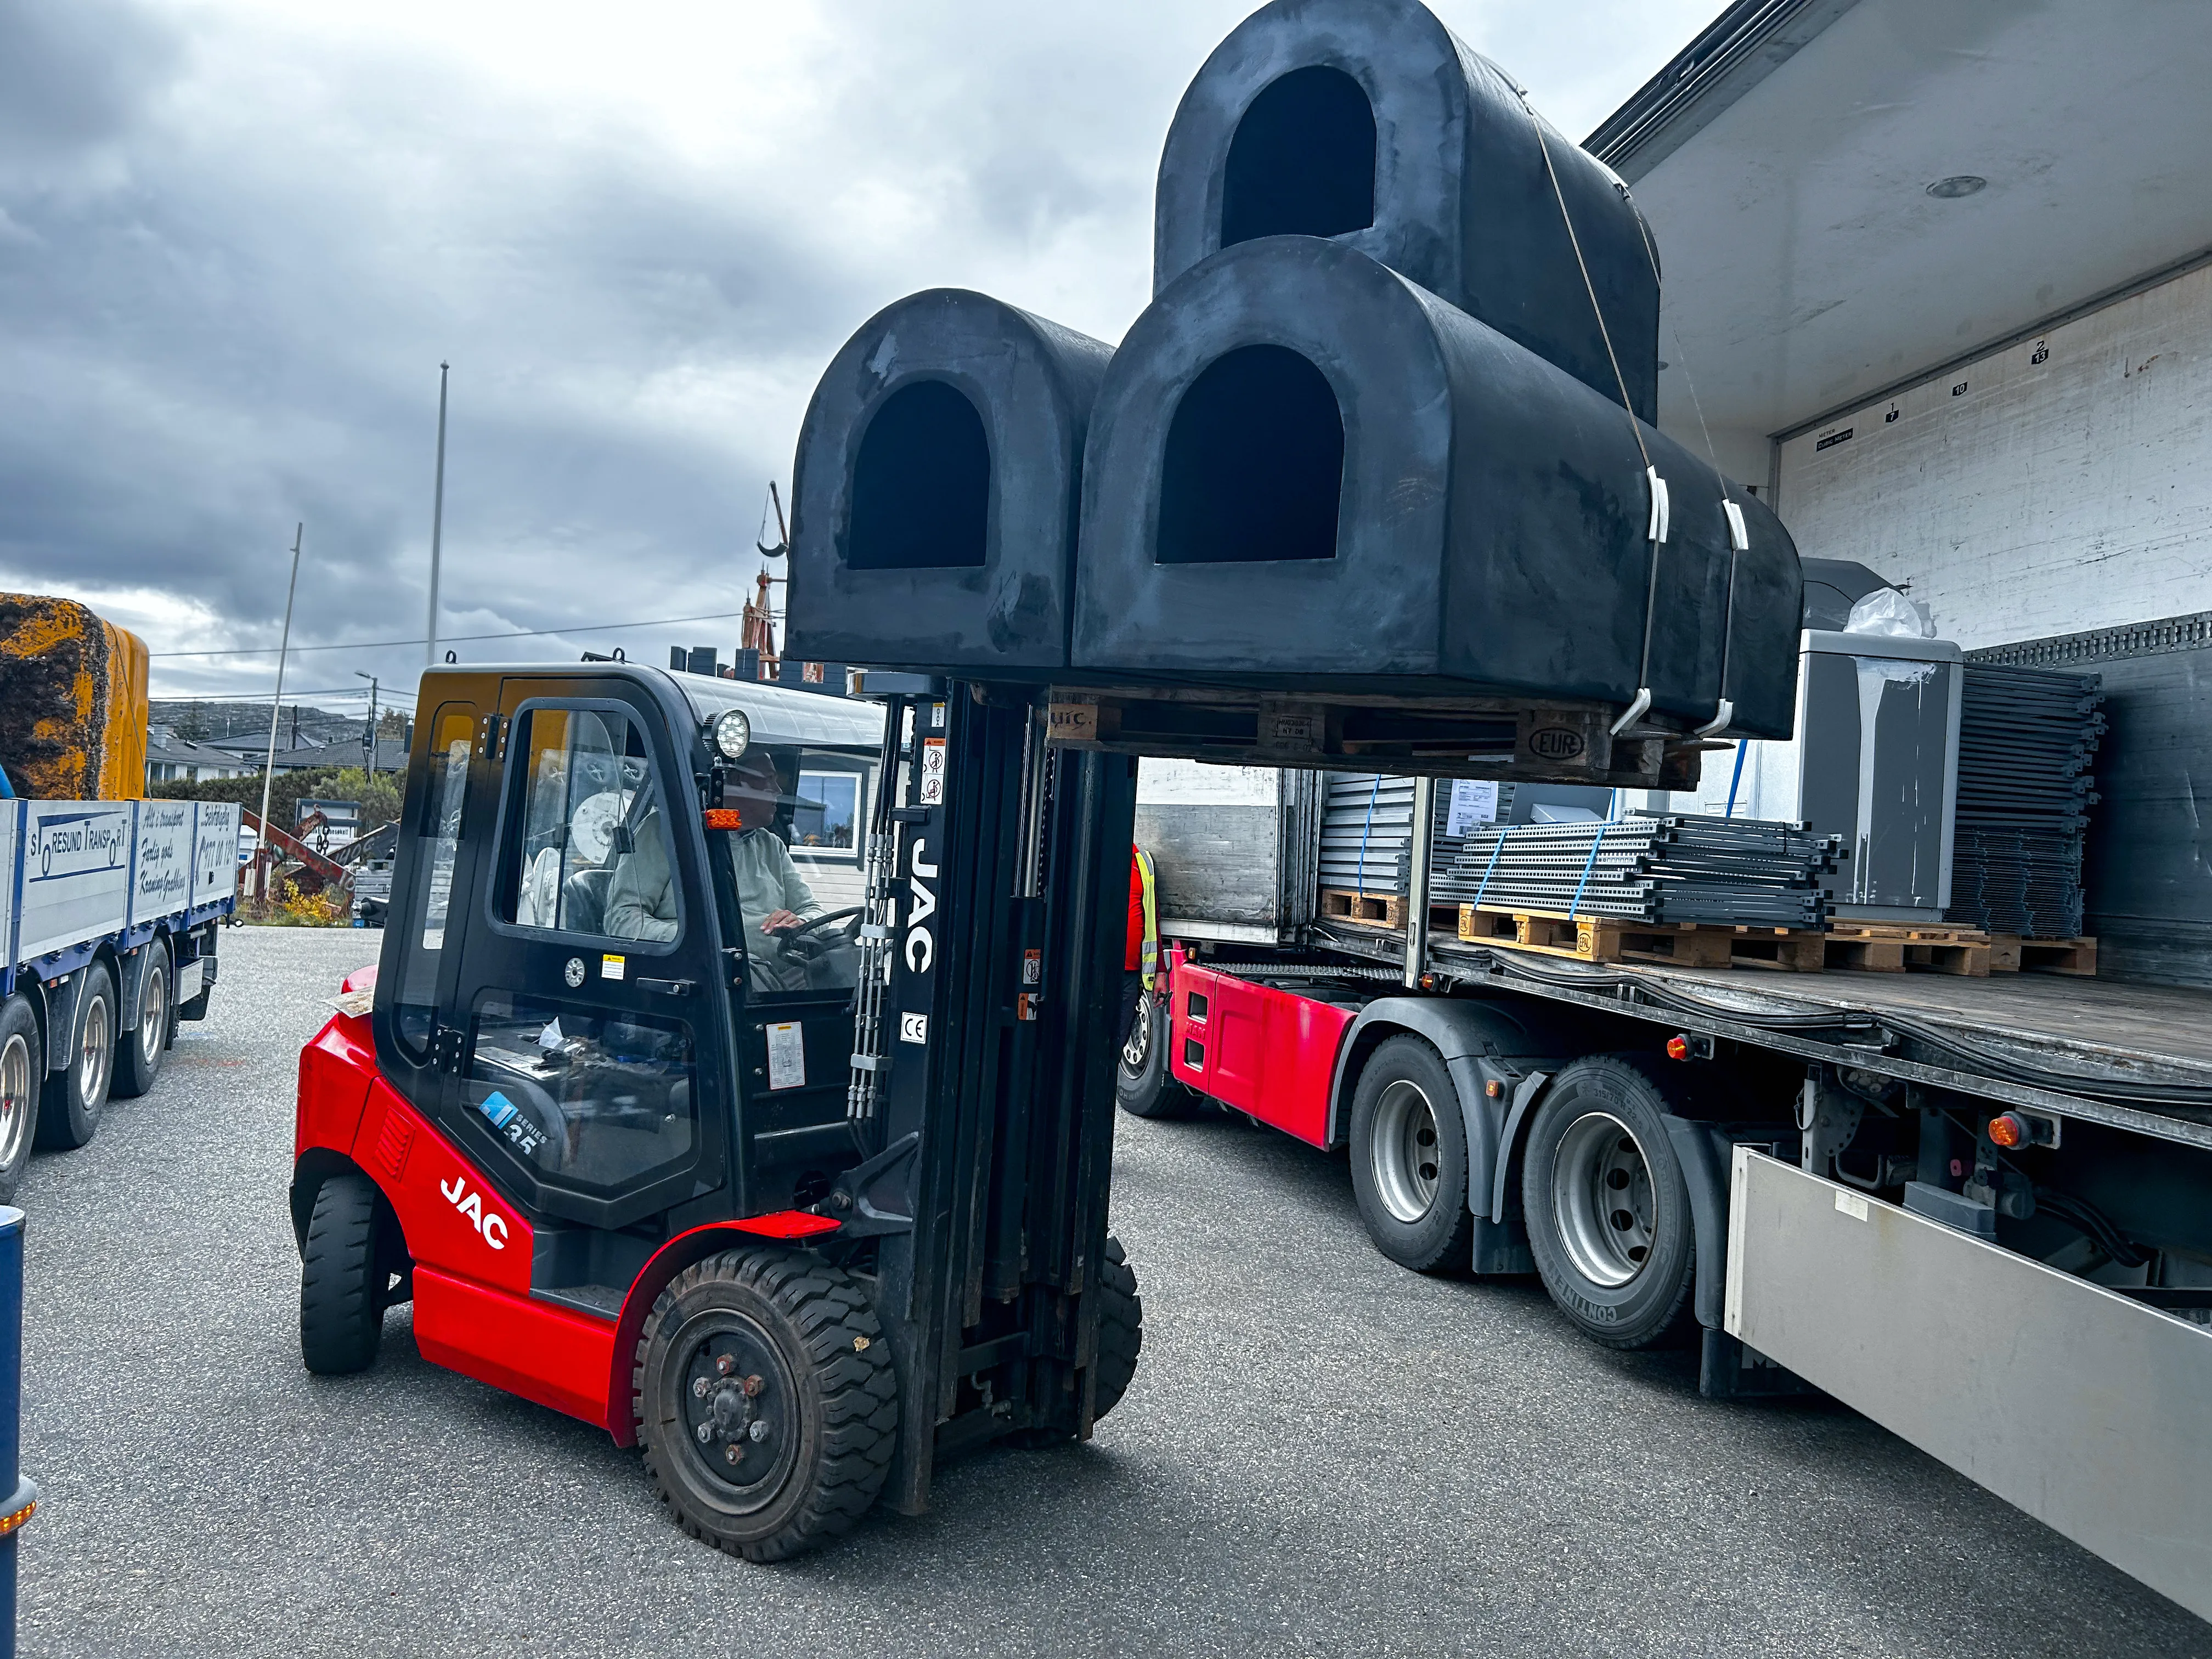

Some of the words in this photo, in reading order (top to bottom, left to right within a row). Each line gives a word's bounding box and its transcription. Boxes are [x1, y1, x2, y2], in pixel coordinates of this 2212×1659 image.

[2036, 340, 2045, 352] 2
[2035, 352, 2046, 363] 13
[1955, 384, 1965, 395] 10
[1891, 412, 1895, 421] 7
[1819, 429, 1835, 438] METER
[1539, 733, 1579, 754] EUR
[160, 809, 184, 833] transport
[84, 819, 127, 867] TRANSPORT
[140, 837, 160, 869] Farlig
[161, 838, 173, 868] gods
[905, 838, 938, 973] JAC
[1579, 936, 1589, 949] EPAL
[905, 1018, 924, 1038] CE
[504, 1124, 537, 1155] 35
[516, 1114, 548, 1144] SERIES
[441, 1176, 508, 1250] JAC
